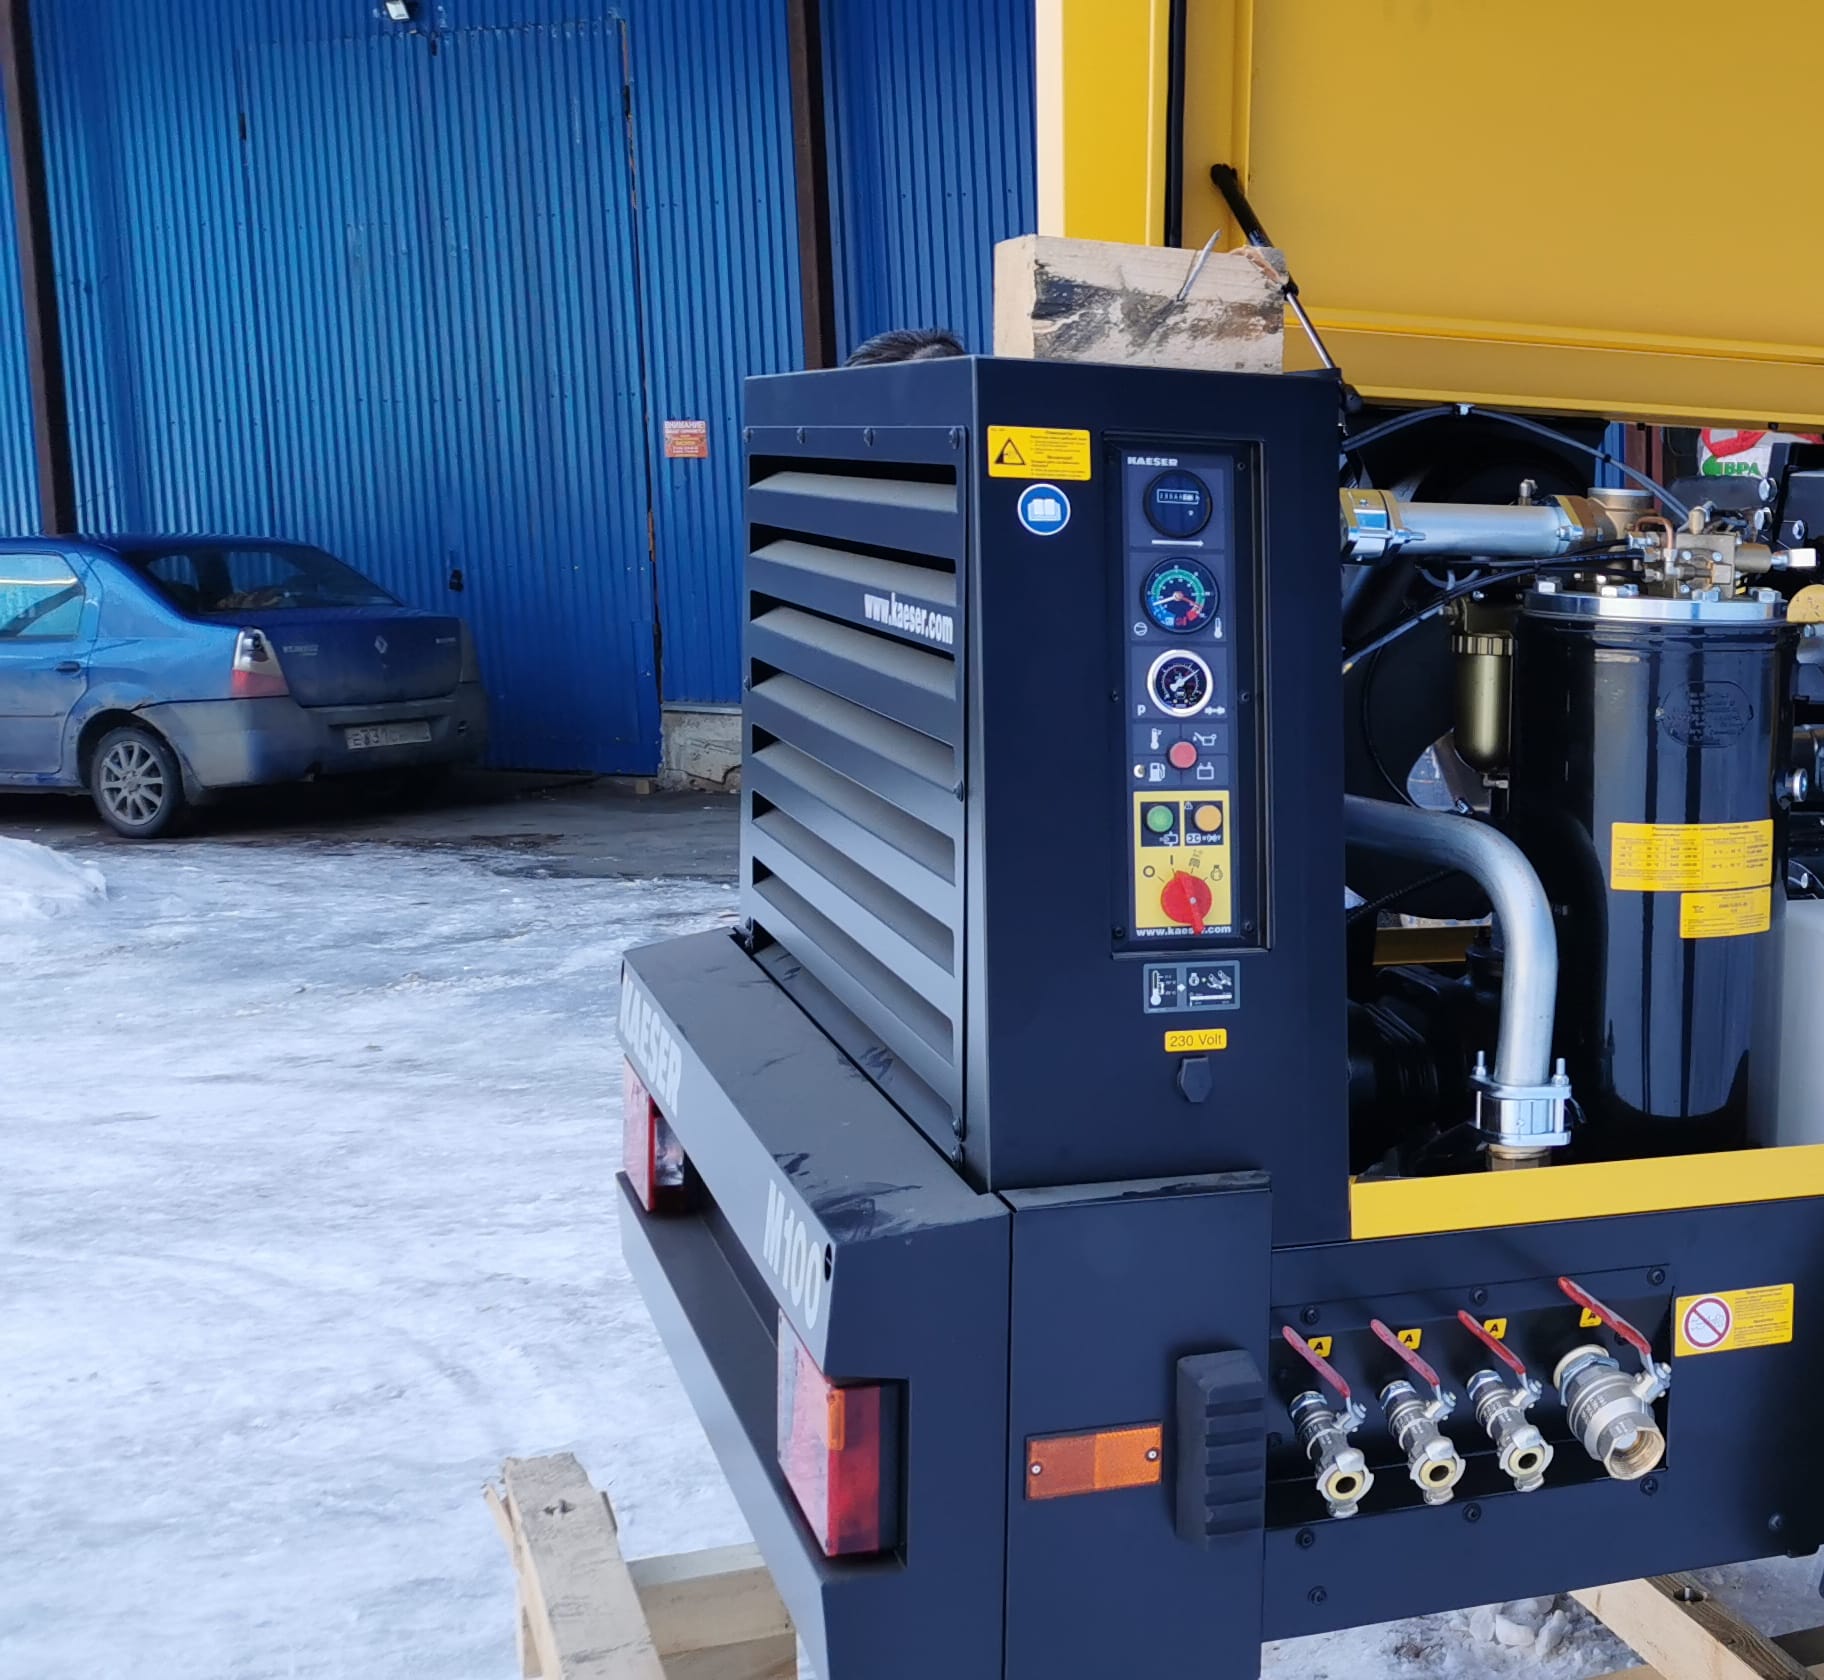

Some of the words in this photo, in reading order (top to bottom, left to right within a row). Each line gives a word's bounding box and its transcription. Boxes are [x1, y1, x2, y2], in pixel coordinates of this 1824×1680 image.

[1127, 457, 1178, 466] KAESER
[864, 592, 953, 645] www.kaeser.com
[1136, 925, 1232, 937] www.kaes.com
[619, 973, 683, 1118] KAESER
[1170, 1035, 1194, 1047] 230
[1199, 1033, 1222, 1045] Volt
[763, 1179, 821, 1329] M100
[1490, 1323, 1499, 1333] A
[1403, 1334, 1413, 1343] A
[1313, 1342, 1324, 1351] A
